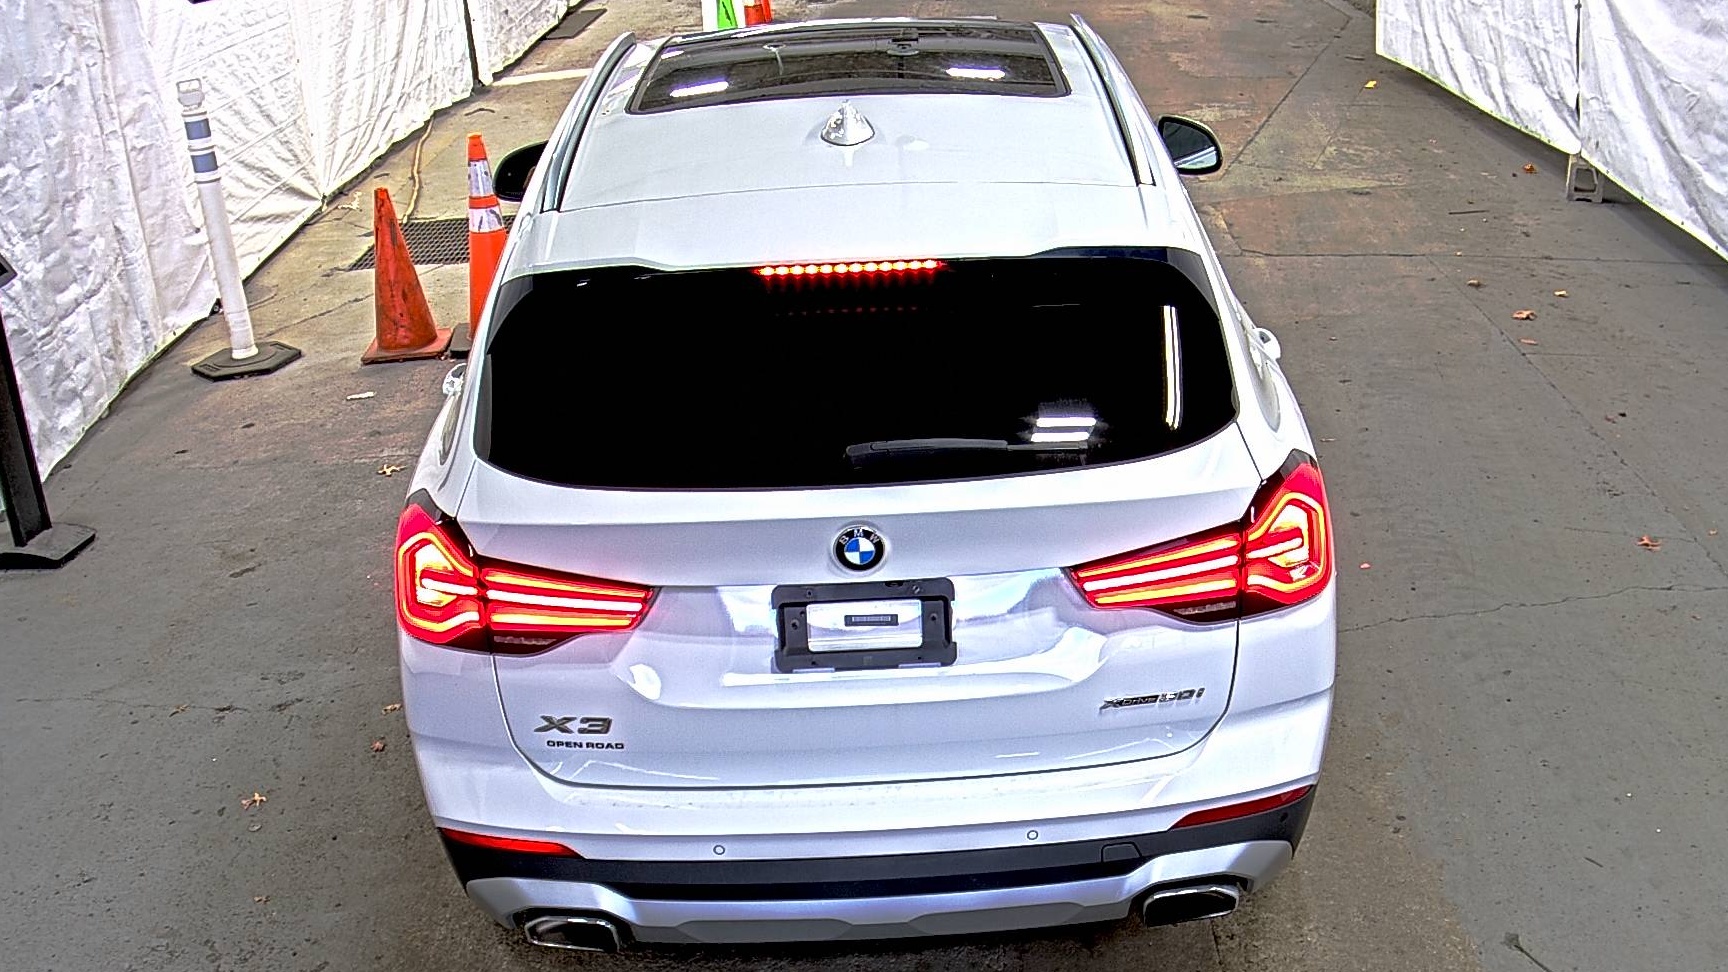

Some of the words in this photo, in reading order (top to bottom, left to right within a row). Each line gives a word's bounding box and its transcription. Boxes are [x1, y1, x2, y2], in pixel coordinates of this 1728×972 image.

[838, 527, 880, 545] BMW
[533, 715, 613, 735] X3
[546, 740, 583, 749] OPEN
[585, 741, 625, 750] ROAD
